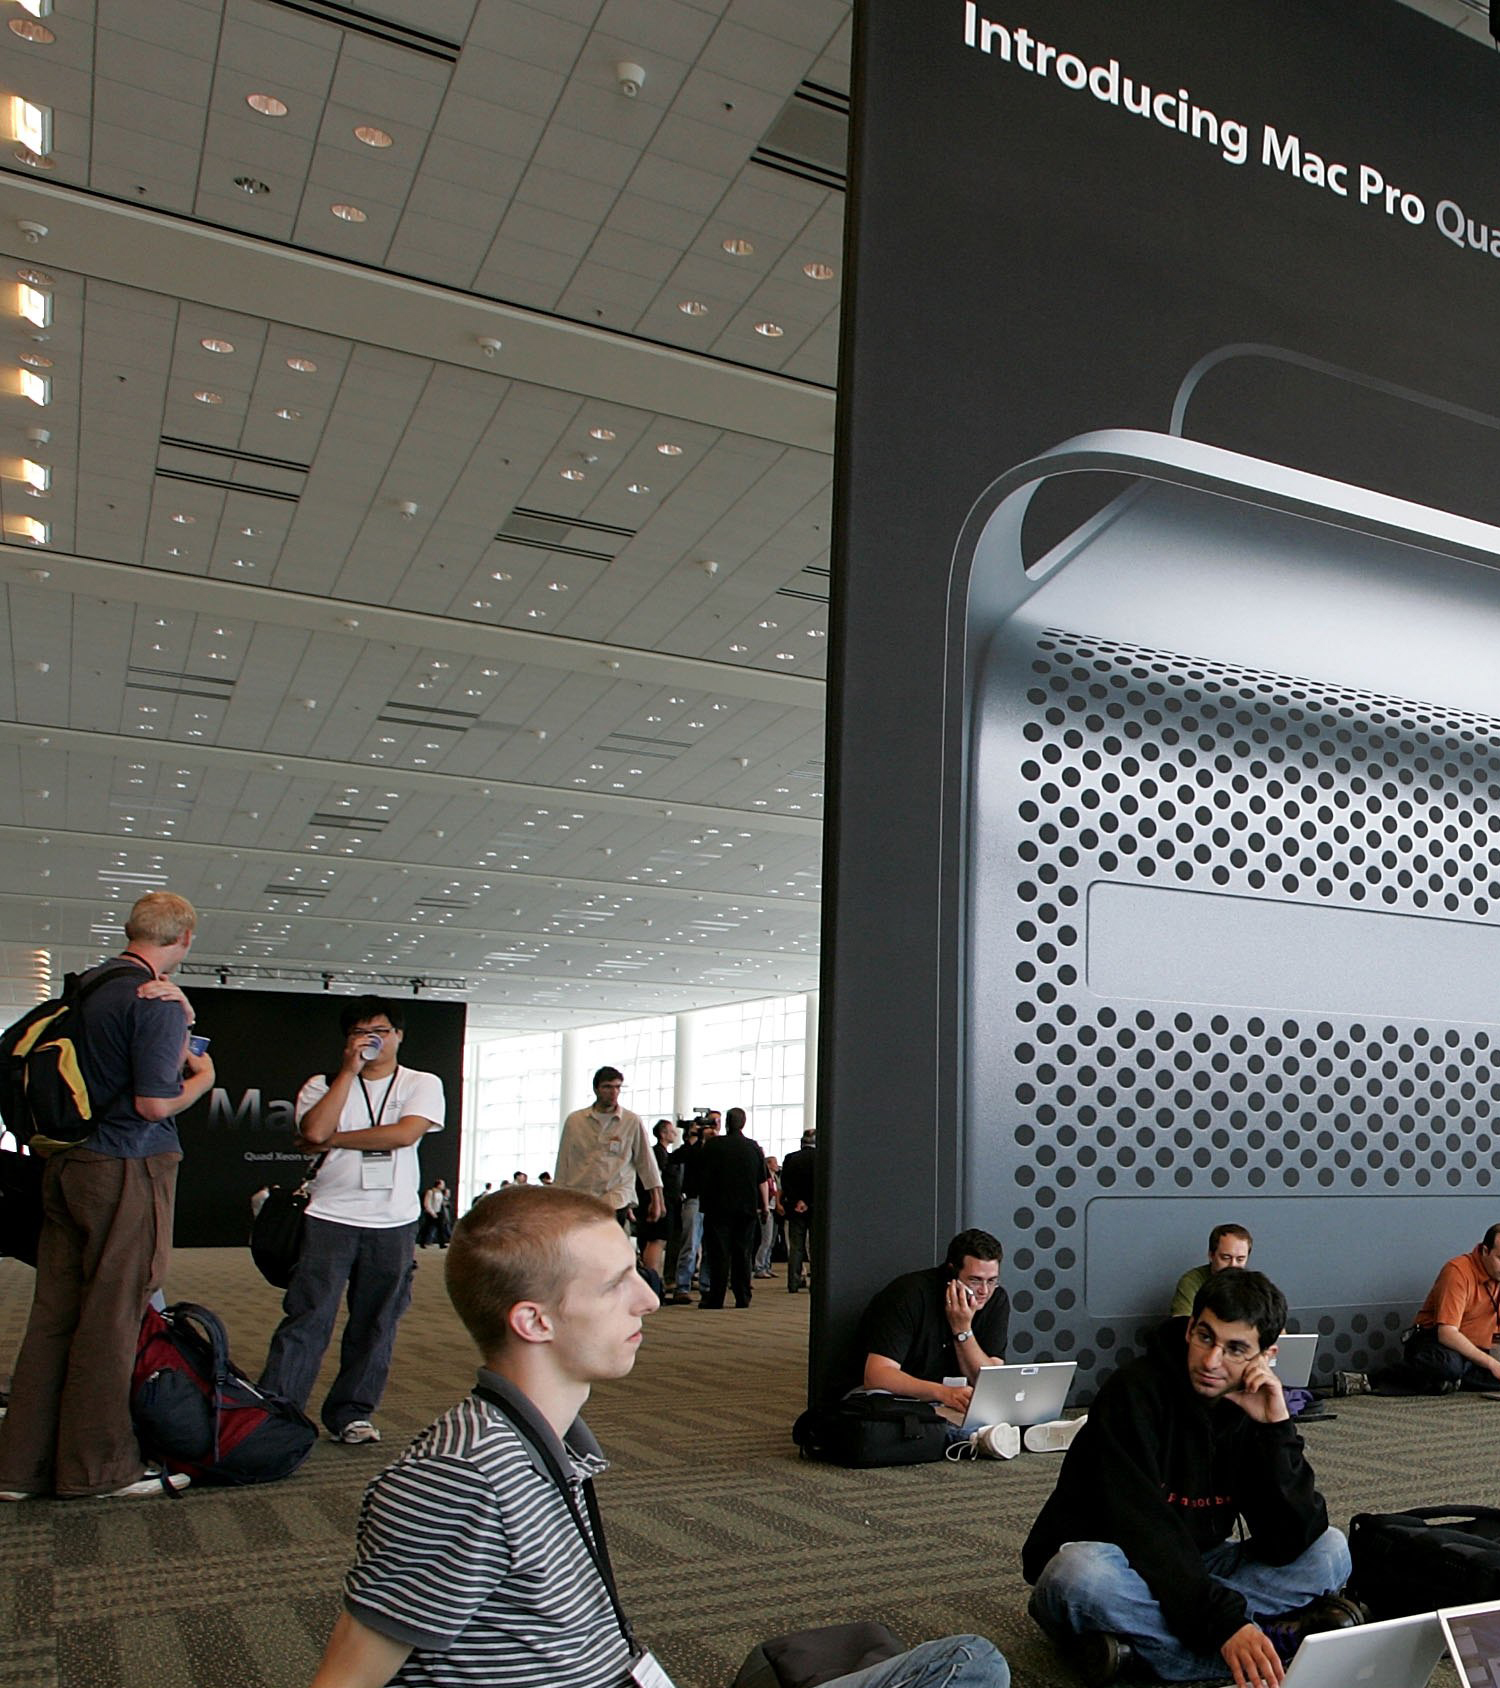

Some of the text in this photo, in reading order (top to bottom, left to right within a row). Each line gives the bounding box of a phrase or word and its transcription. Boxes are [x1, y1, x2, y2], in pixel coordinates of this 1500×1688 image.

[964, 1, 1249, 165] Introducing
[1261, 124, 1348, 197] Mac
[1359, 164, 1426, 226] Pro
[208, 1087, 295, 1132] Ma
[244, 1152, 273, 1162] Quad
